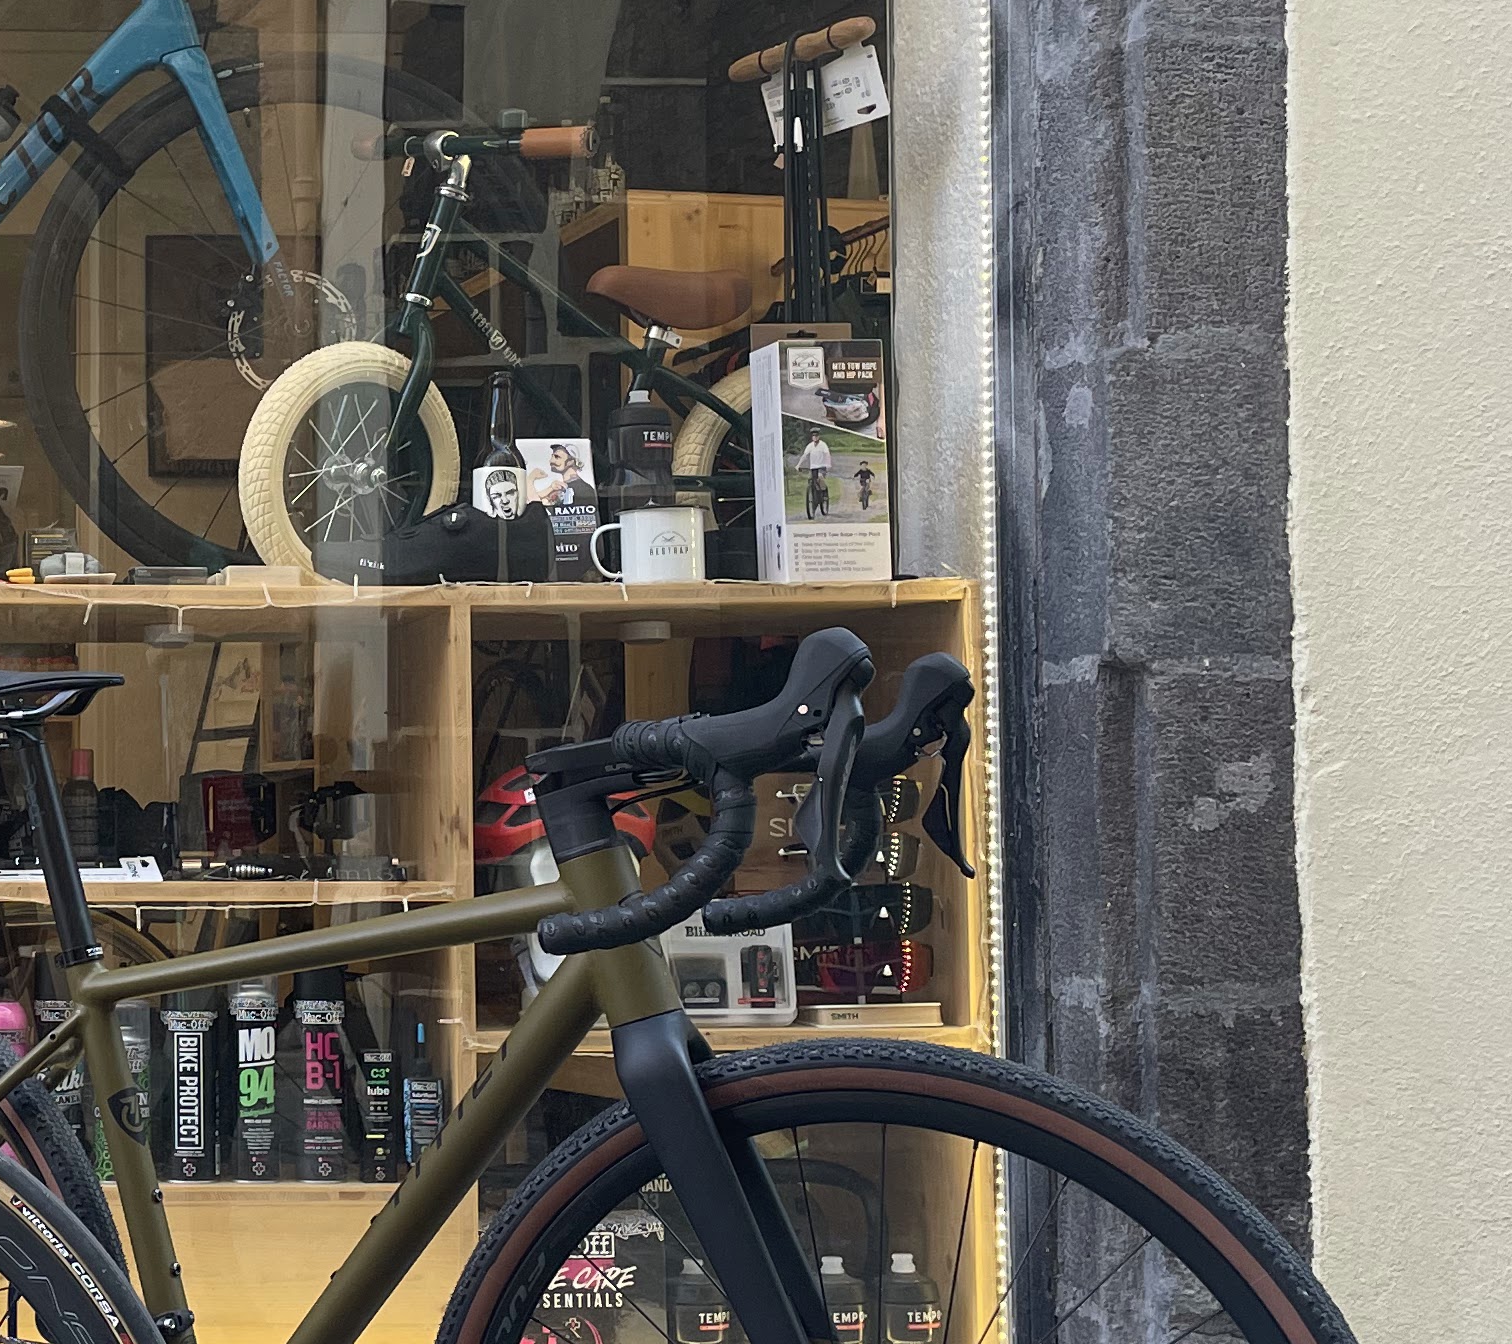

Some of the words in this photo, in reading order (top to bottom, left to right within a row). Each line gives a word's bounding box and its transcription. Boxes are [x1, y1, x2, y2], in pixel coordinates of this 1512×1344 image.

[178, 1037, 199, 1073] BIKE
[238, 1026, 276, 1063] MO
[305, 1031, 340, 1061] HC
[239, 1066, 276, 1107] 94
[305, 1062, 341, 1091] B-1
[179, 1076, 199, 1145] PROTECT
[22, 1207, 71, 1259] vittoria
[70, 1260, 120, 1329] CORSA
[572, 1265, 638, 1293] CARE
[831, 1311, 866, 1323] EMPO
